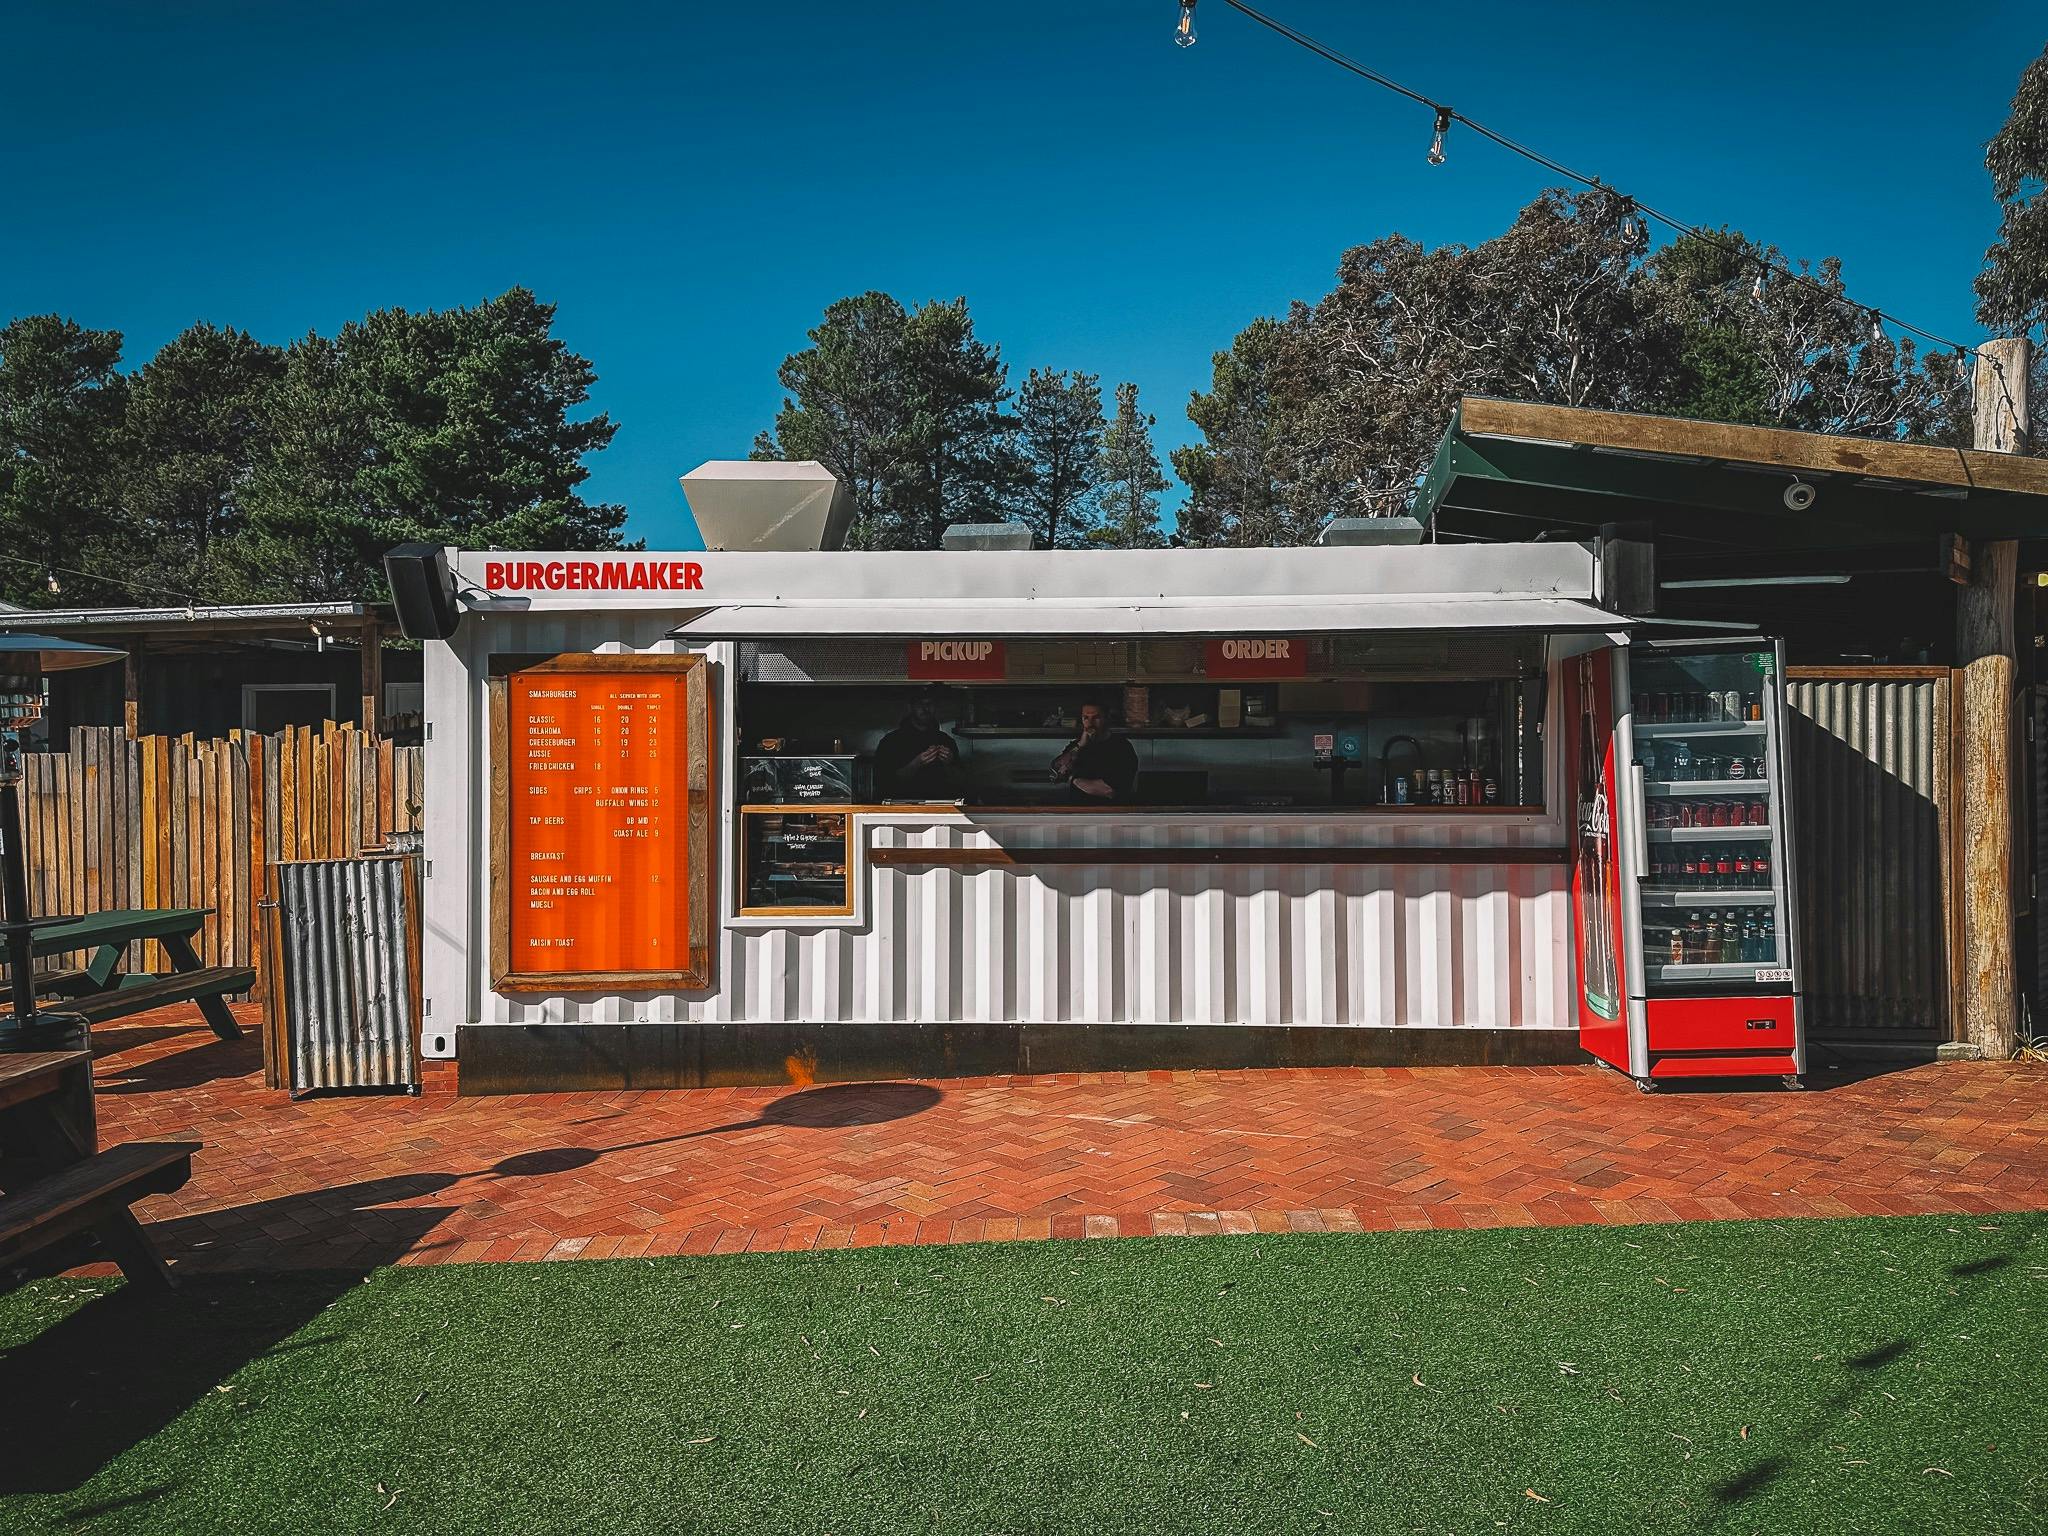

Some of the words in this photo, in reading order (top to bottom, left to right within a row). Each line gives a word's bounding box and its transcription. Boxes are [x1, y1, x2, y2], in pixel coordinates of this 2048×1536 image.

[485, 561, 704, 590] BURGERMAKER
[921, 641, 993, 661] PICKUP
[1222, 639, 1290, 659] ORDER
[529, 690, 577, 699] SMASHBURGERS
[529, 715, 556, 724] CLASSIC
[594, 715, 601, 724] 16
[621, 715, 630, 724] 20
[649, 715, 657, 724] 24
[529, 727, 562, 735] OKLAHOMA
[594, 727, 601, 735] 16
[621, 727, 630, 735] 20
[649, 727, 657, 735] 24
[529, 738, 576, 747] CHEESEBURGER
[594, 738, 601, 747] 15
[621, 738, 628, 747] 19
[529, 750, 551, 758] AUSSIE
[621, 750, 629, 758] 21
[529, 762, 548, 770] FRIED
[549, 762, 575, 771] CHICKEN
[529, 786, 548, 795] SIDES
[574, 786, 593, 794] CHIPS
[611, 786, 628, 794] ONION
[630, 786, 649, 794] RINGS
[595, 799, 625, 807] BUFFALO
[629, 799, 649, 807] WINGS
[652, 799, 659, 807] 12
[530, 816, 542, 825] TAP
[544, 816, 565, 825] BEERS
[613, 829, 634, 838] COAST
[637, 829, 648, 838] ALE
[530, 852, 565, 861] BREAKFAST
[530, 875, 558, 883] SAUSAGE
[560, 875, 572, 883] AND
[574, 875, 586, 883] EGG
[588, 875, 612, 883] MUFFIN
[530, 888, 551, 896] BACON
[552, 888, 564, 896] AND
[566, 888, 579, 896] EGG
[581, 888, 596, 896] ROLL
[530, 900, 554, 909] MUESLI
[530, 938, 552, 947] RAISIN
[555, 938, 575, 947] TOAST
